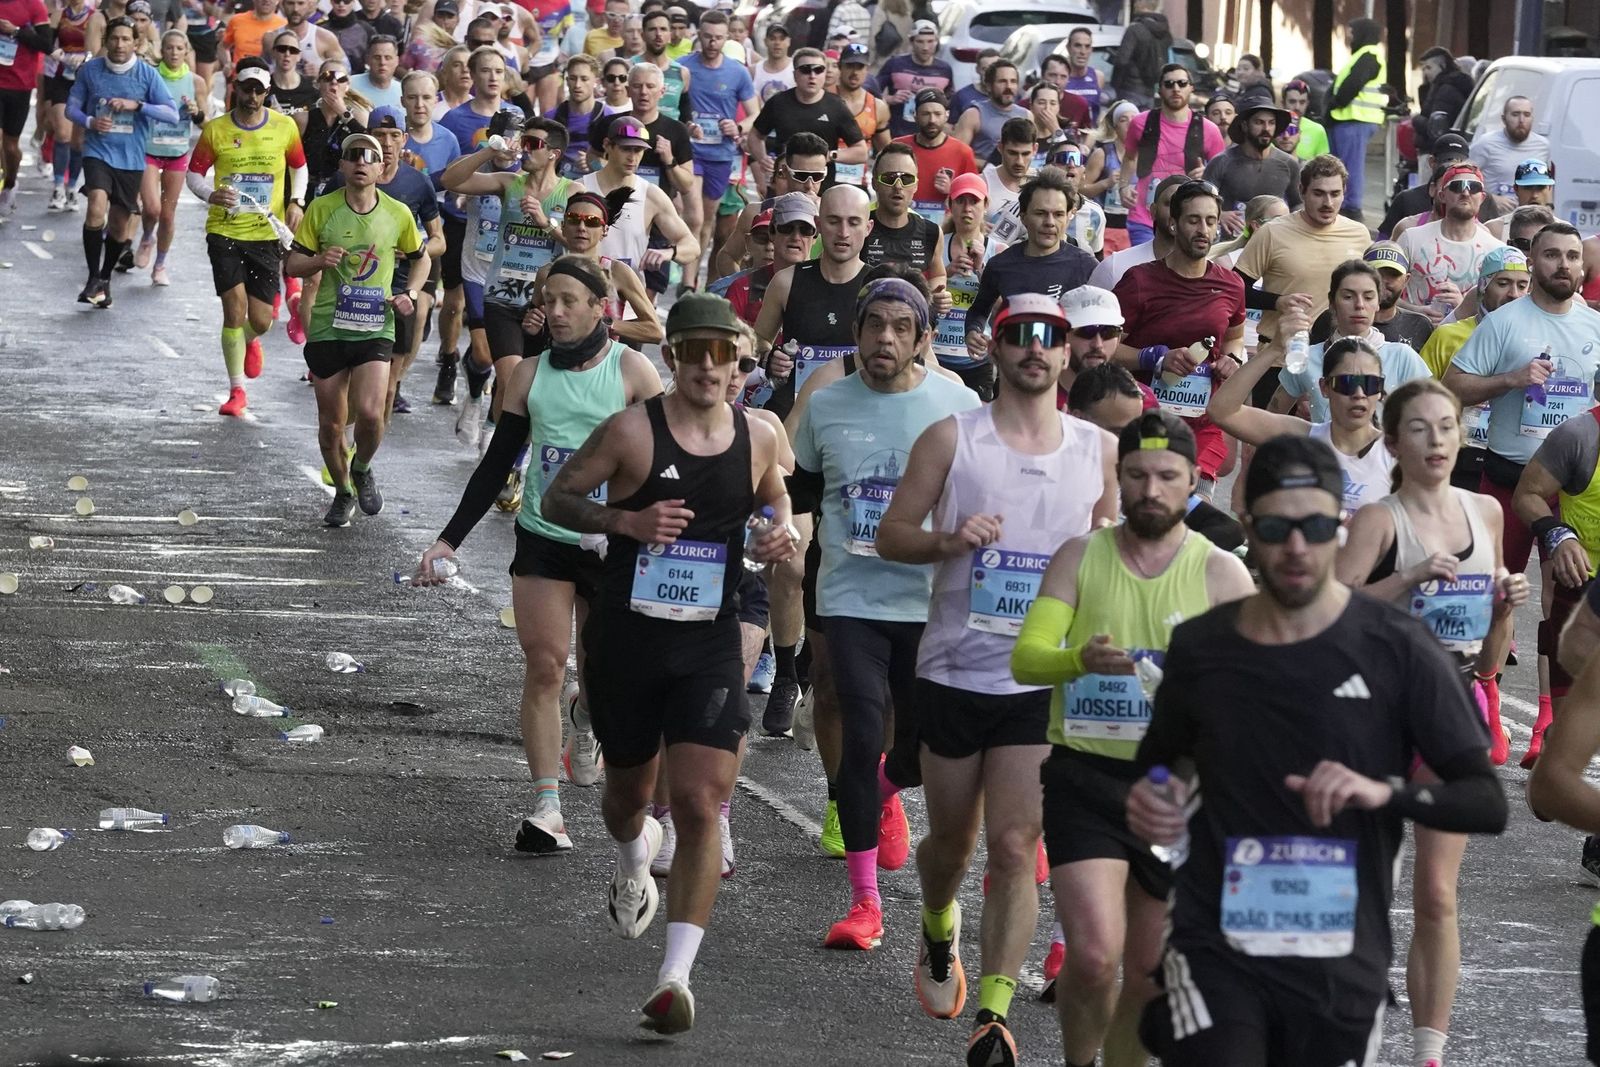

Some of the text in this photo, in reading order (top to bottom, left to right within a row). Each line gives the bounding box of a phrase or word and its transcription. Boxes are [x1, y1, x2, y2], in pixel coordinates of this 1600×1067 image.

[519, 237, 547, 247] ZURICH
[354, 289, 382, 297] ZURICH
[352, 301, 371, 309] 16220
[334, 309, 386, 323] DURANOSEVIC
[1548, 384, 1582, 394] ZURICH
[1547, 401, 1565, 410] 7241
[669, 544, 718, 559] ZURICH
[1006, 555, 1050, 570] ZURIC
[668, 568, 694, 581] 6144
[1005, 580, 1032, 594] 6931
[1443, 579, 1486, 592] ZURICH
[656, 583, 700, 602] COKE
[1443, 604, 1467, 616] 7231
[1434, 618, 1466, 637] MIA
[1098, 680, 1128, 693] 8492
